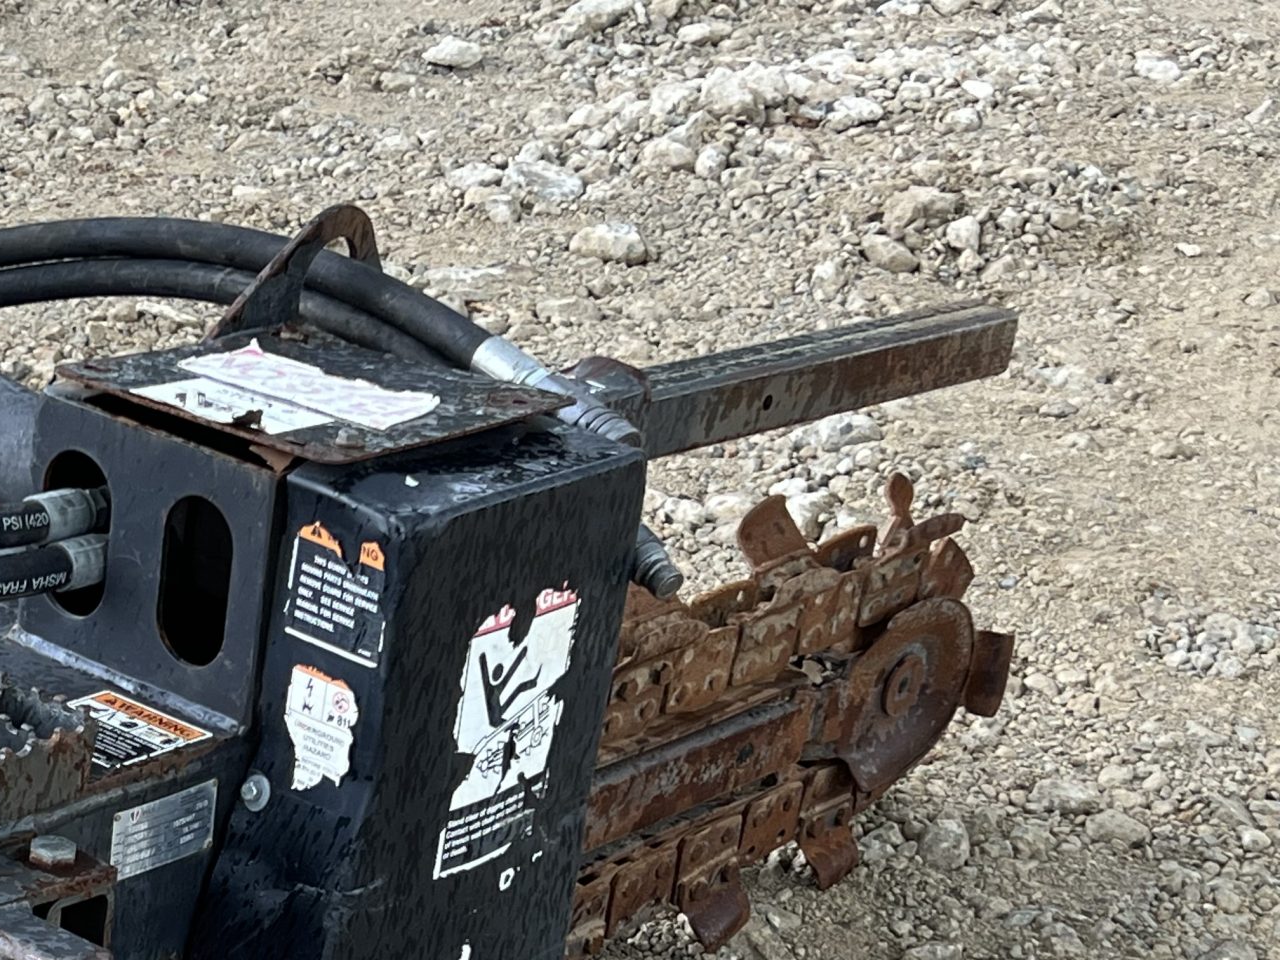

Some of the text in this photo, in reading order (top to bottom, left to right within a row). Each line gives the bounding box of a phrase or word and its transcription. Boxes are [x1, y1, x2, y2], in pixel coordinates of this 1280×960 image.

[2, 515, 23, 531] PSI
[32, 571, 67, 590] MSHA
[119, 702, 192, 738] WARNING
